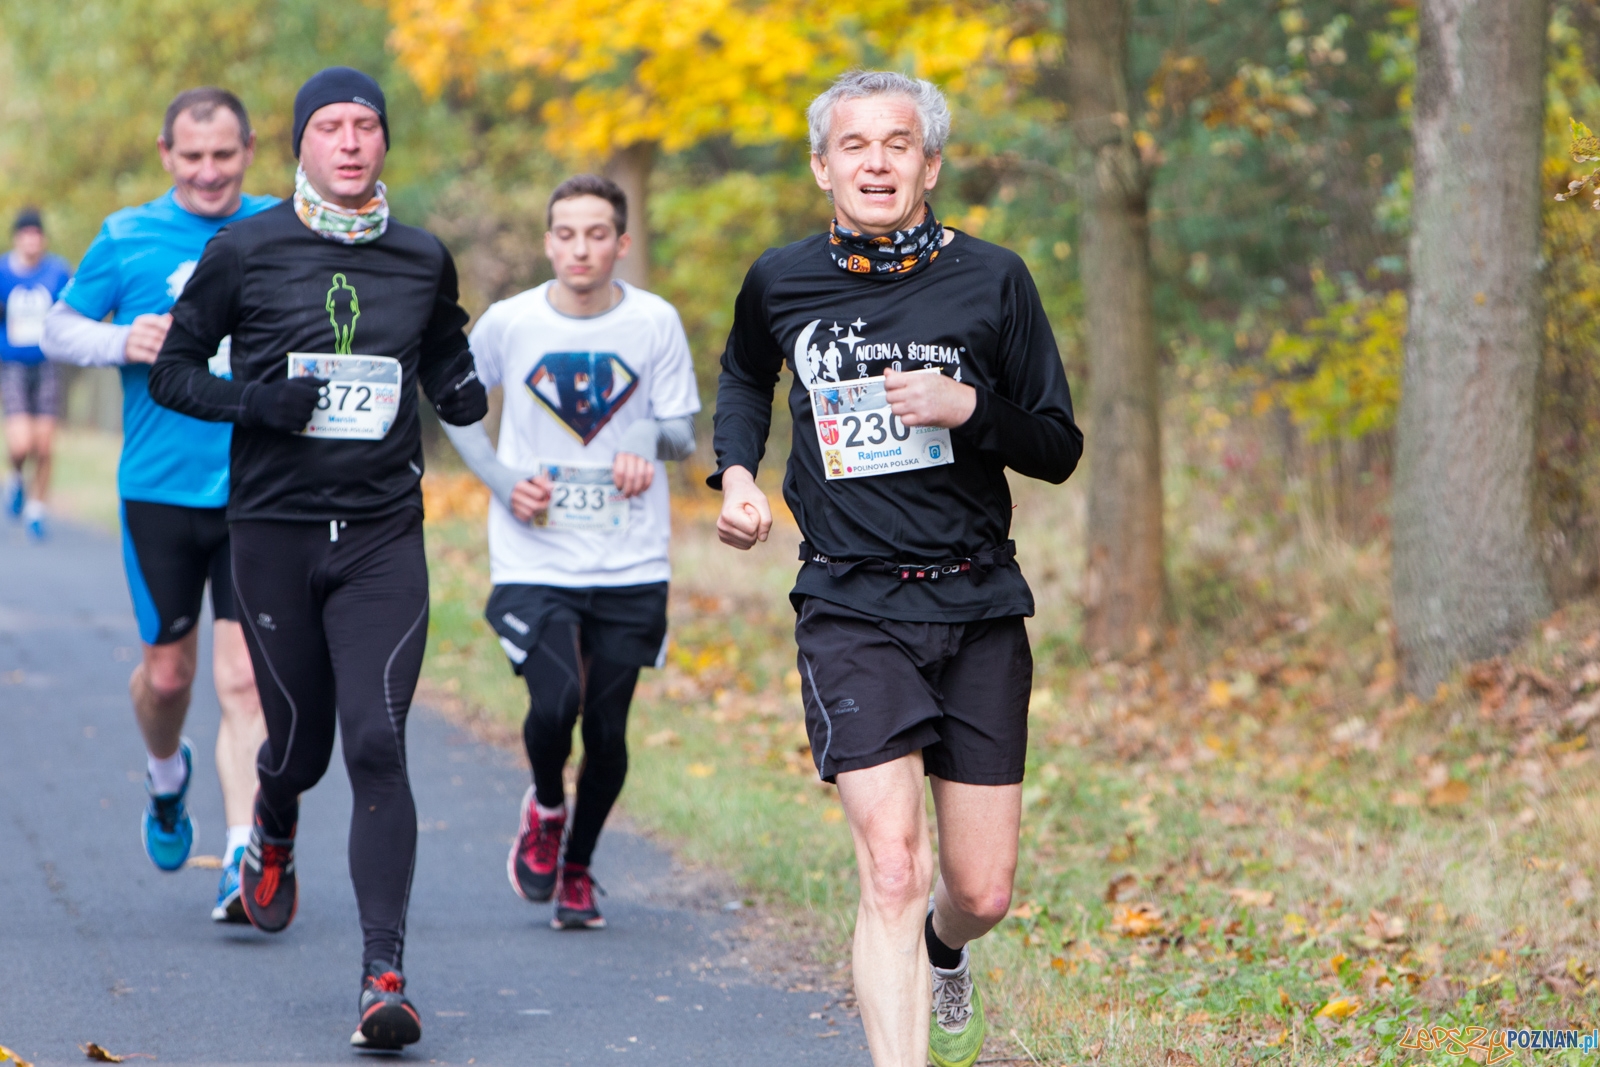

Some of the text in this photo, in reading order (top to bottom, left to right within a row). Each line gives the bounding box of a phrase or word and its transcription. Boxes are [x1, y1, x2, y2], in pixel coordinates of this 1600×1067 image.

[855, 342, 903, 362] NOCNA
[316, 384, 372, 412] 872
[842, 412, 911, 448] 230
[853, 458, 920, 472] POLINOVA POLSKA
[857, 446, 902, 461] Rajmund
[555, 485, 605, 511] 233
